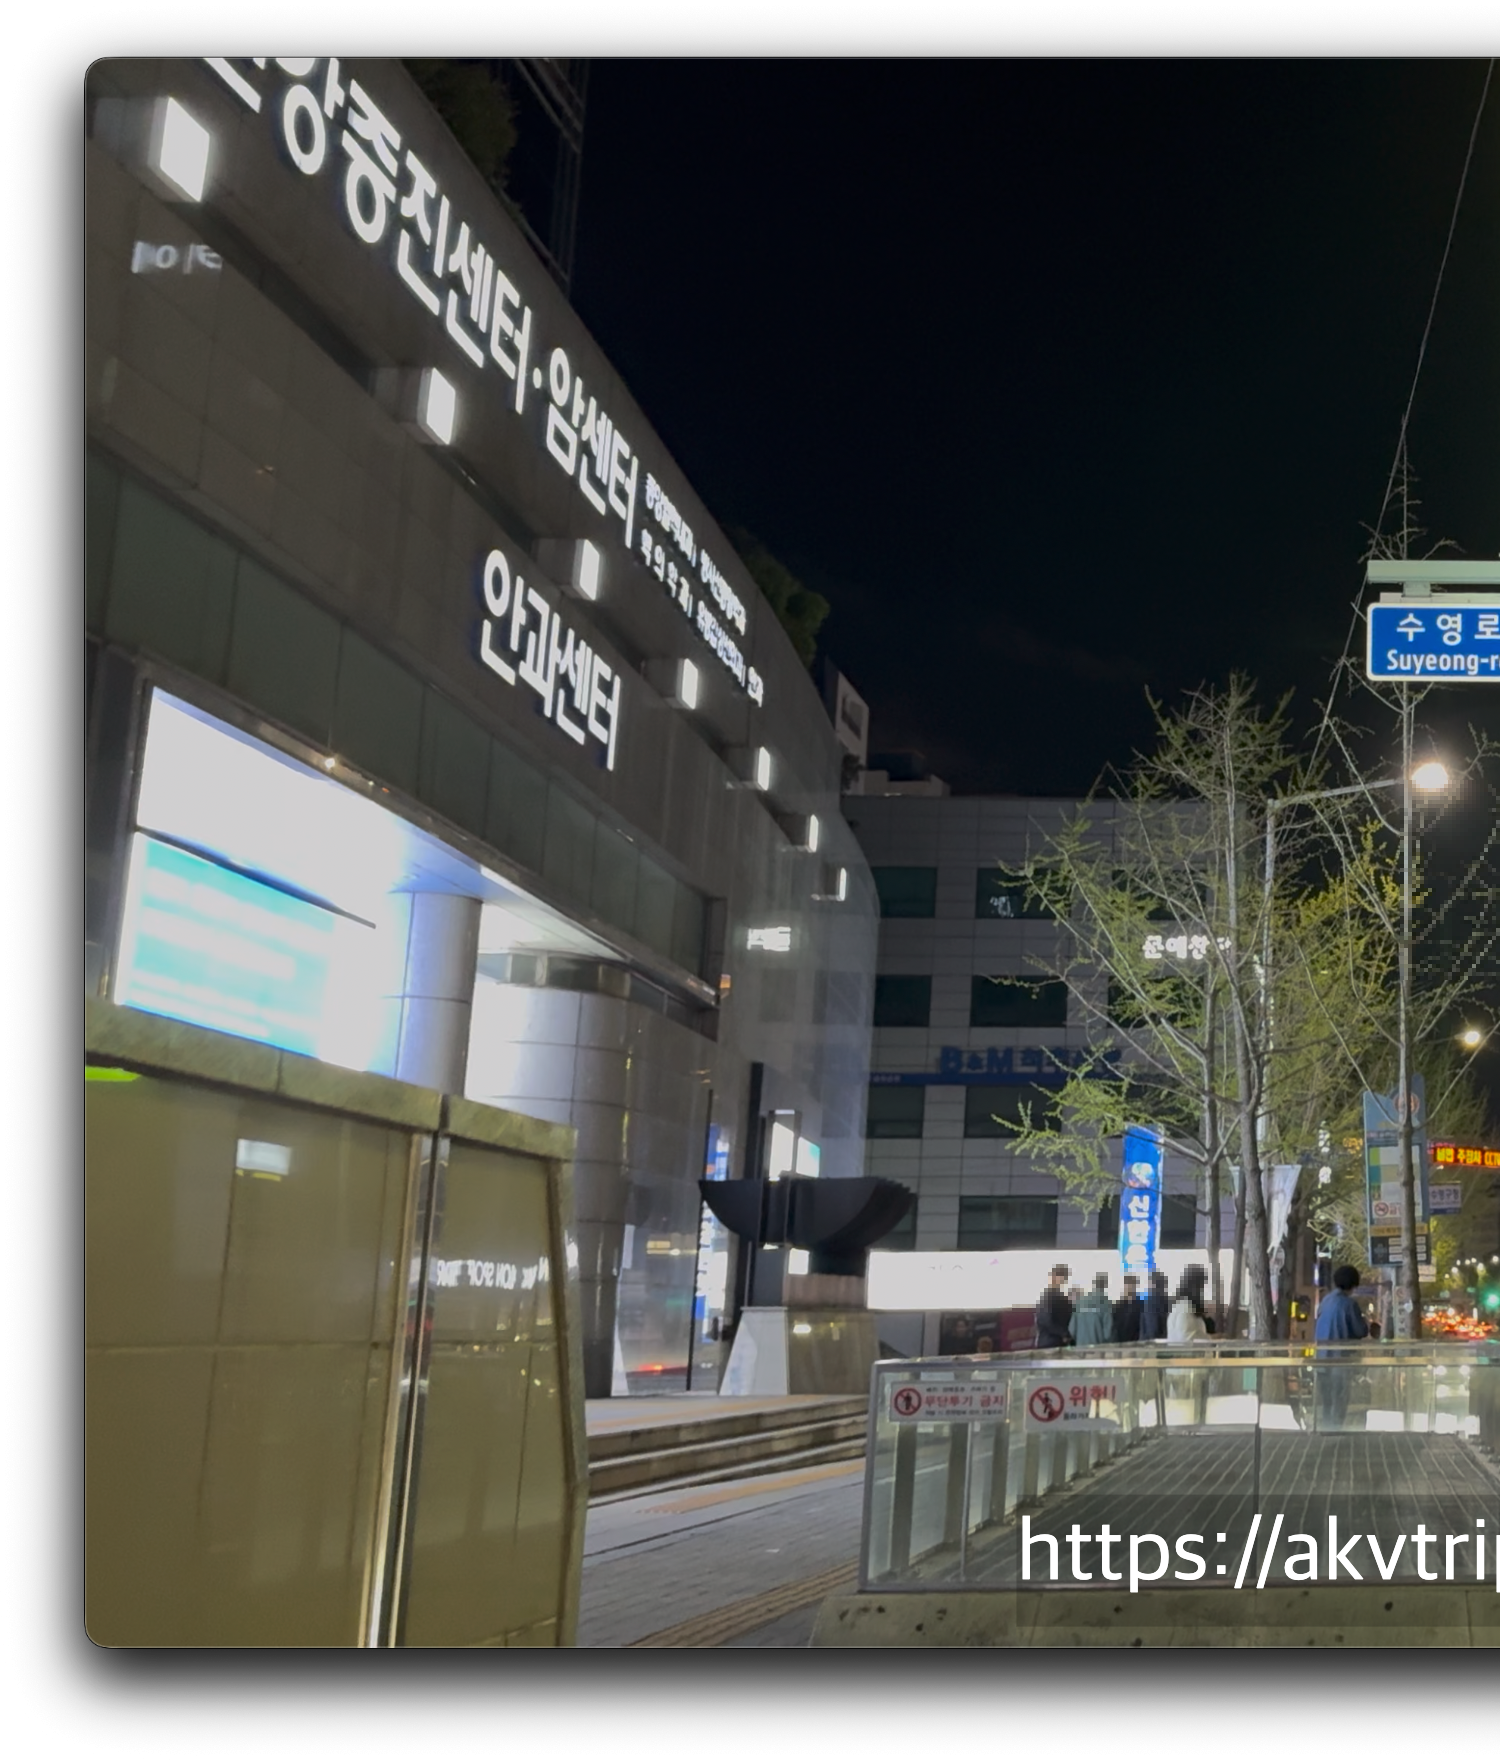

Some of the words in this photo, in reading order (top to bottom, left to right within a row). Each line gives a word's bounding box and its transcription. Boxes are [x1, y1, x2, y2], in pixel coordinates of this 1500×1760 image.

[480, 549, 622, 772] 안과센터
[924, 1394, 973, 1407] 무단투기
[979, 1394, 1004, 1407] 금지
